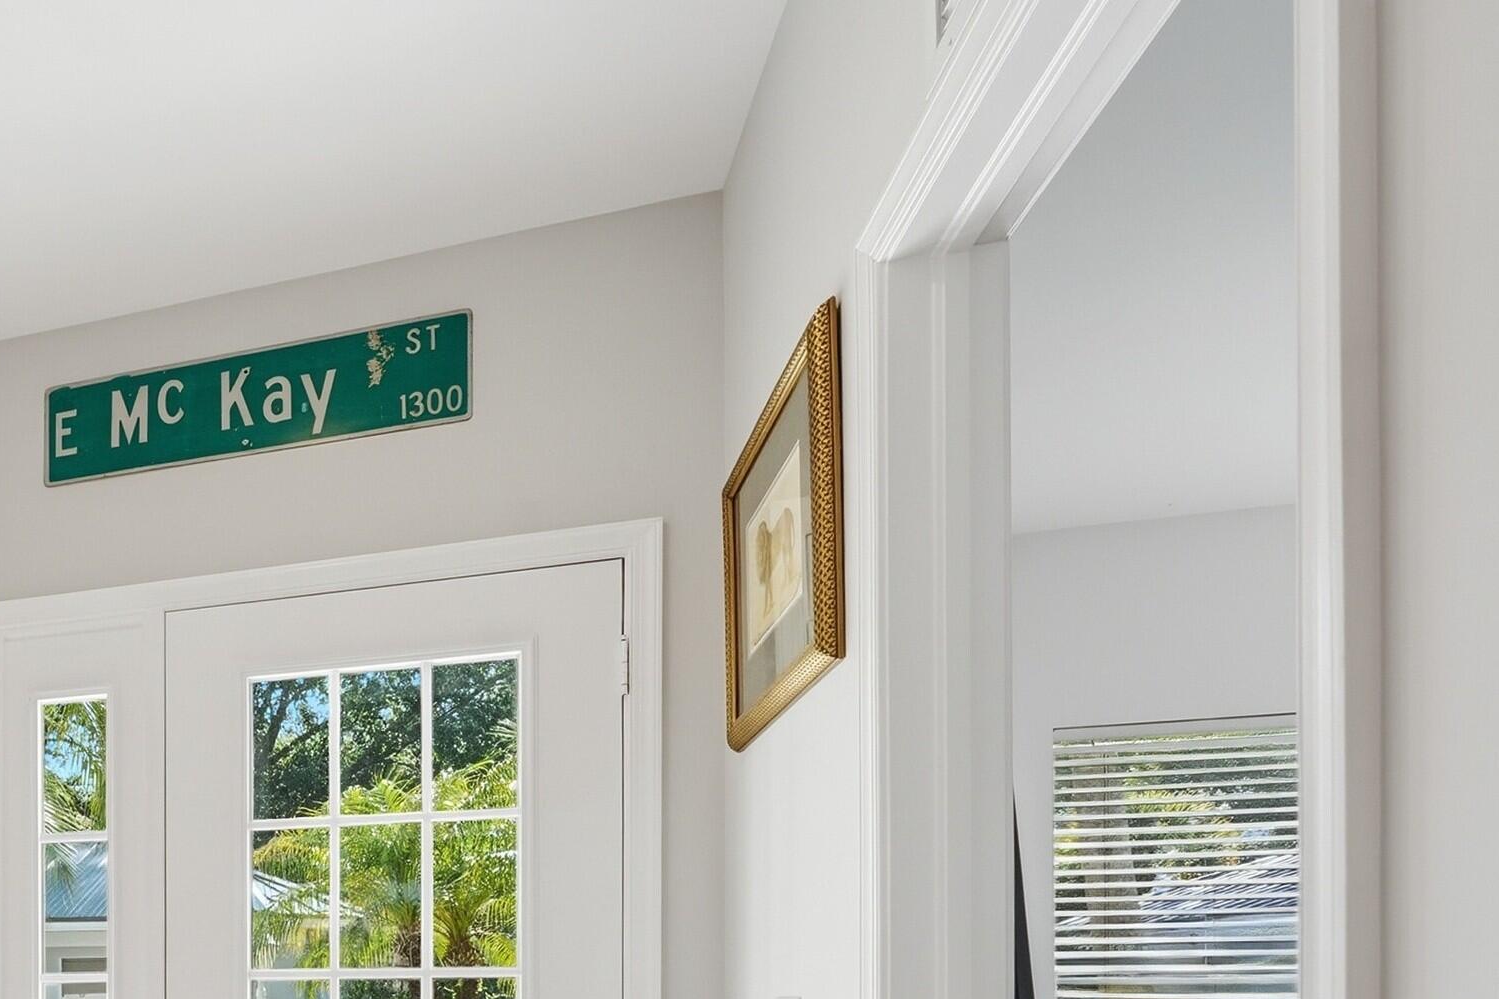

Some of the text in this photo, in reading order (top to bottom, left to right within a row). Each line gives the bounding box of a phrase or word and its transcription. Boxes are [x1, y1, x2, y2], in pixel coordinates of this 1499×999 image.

[54, 409, 77, 458] E
[220, 366, 336, 434] Kay
[405, 324, 441, 354] ST
[399, 384, 463, 420] 1300
